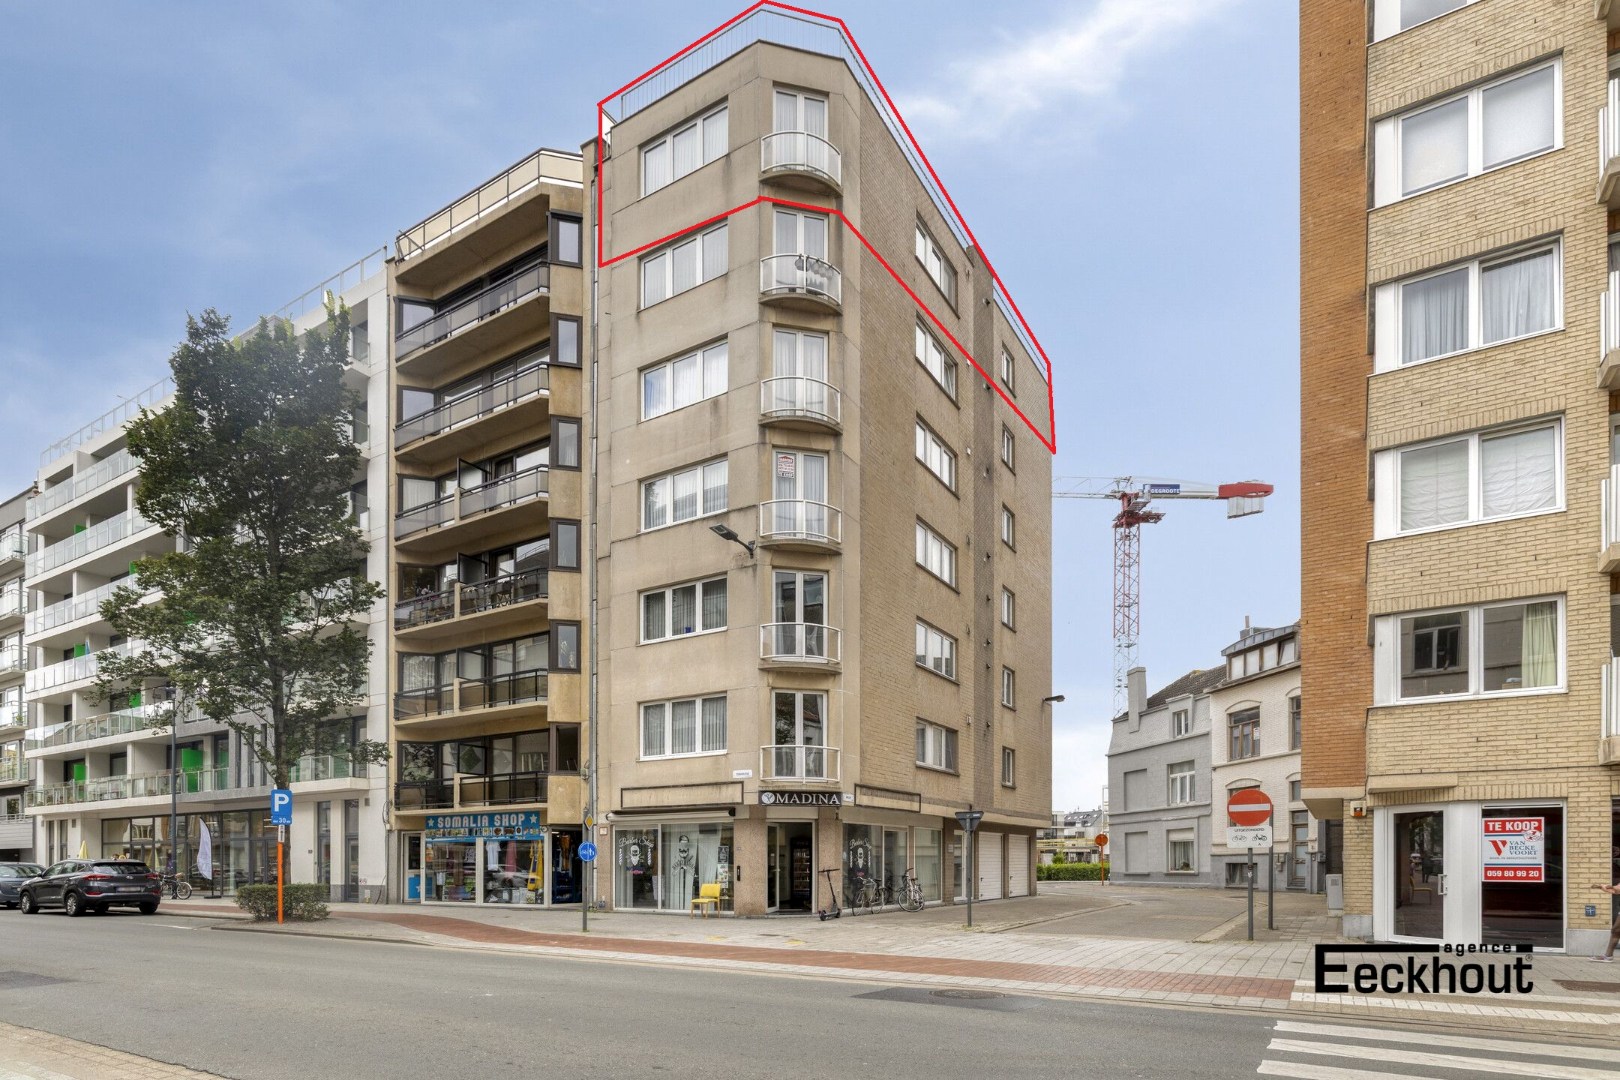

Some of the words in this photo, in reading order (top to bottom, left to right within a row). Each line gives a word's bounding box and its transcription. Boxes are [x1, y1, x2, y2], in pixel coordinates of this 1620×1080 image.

[274, 793, 290, 812] P
[775, 792, 841, 805] MADINA
[437, 815, 489, 828] SOMALIA
[494, 813, 525, 826] SHOP
[1487, 821, 1502, 831] TE
[1505, 821, 1539, 831] KOOP
